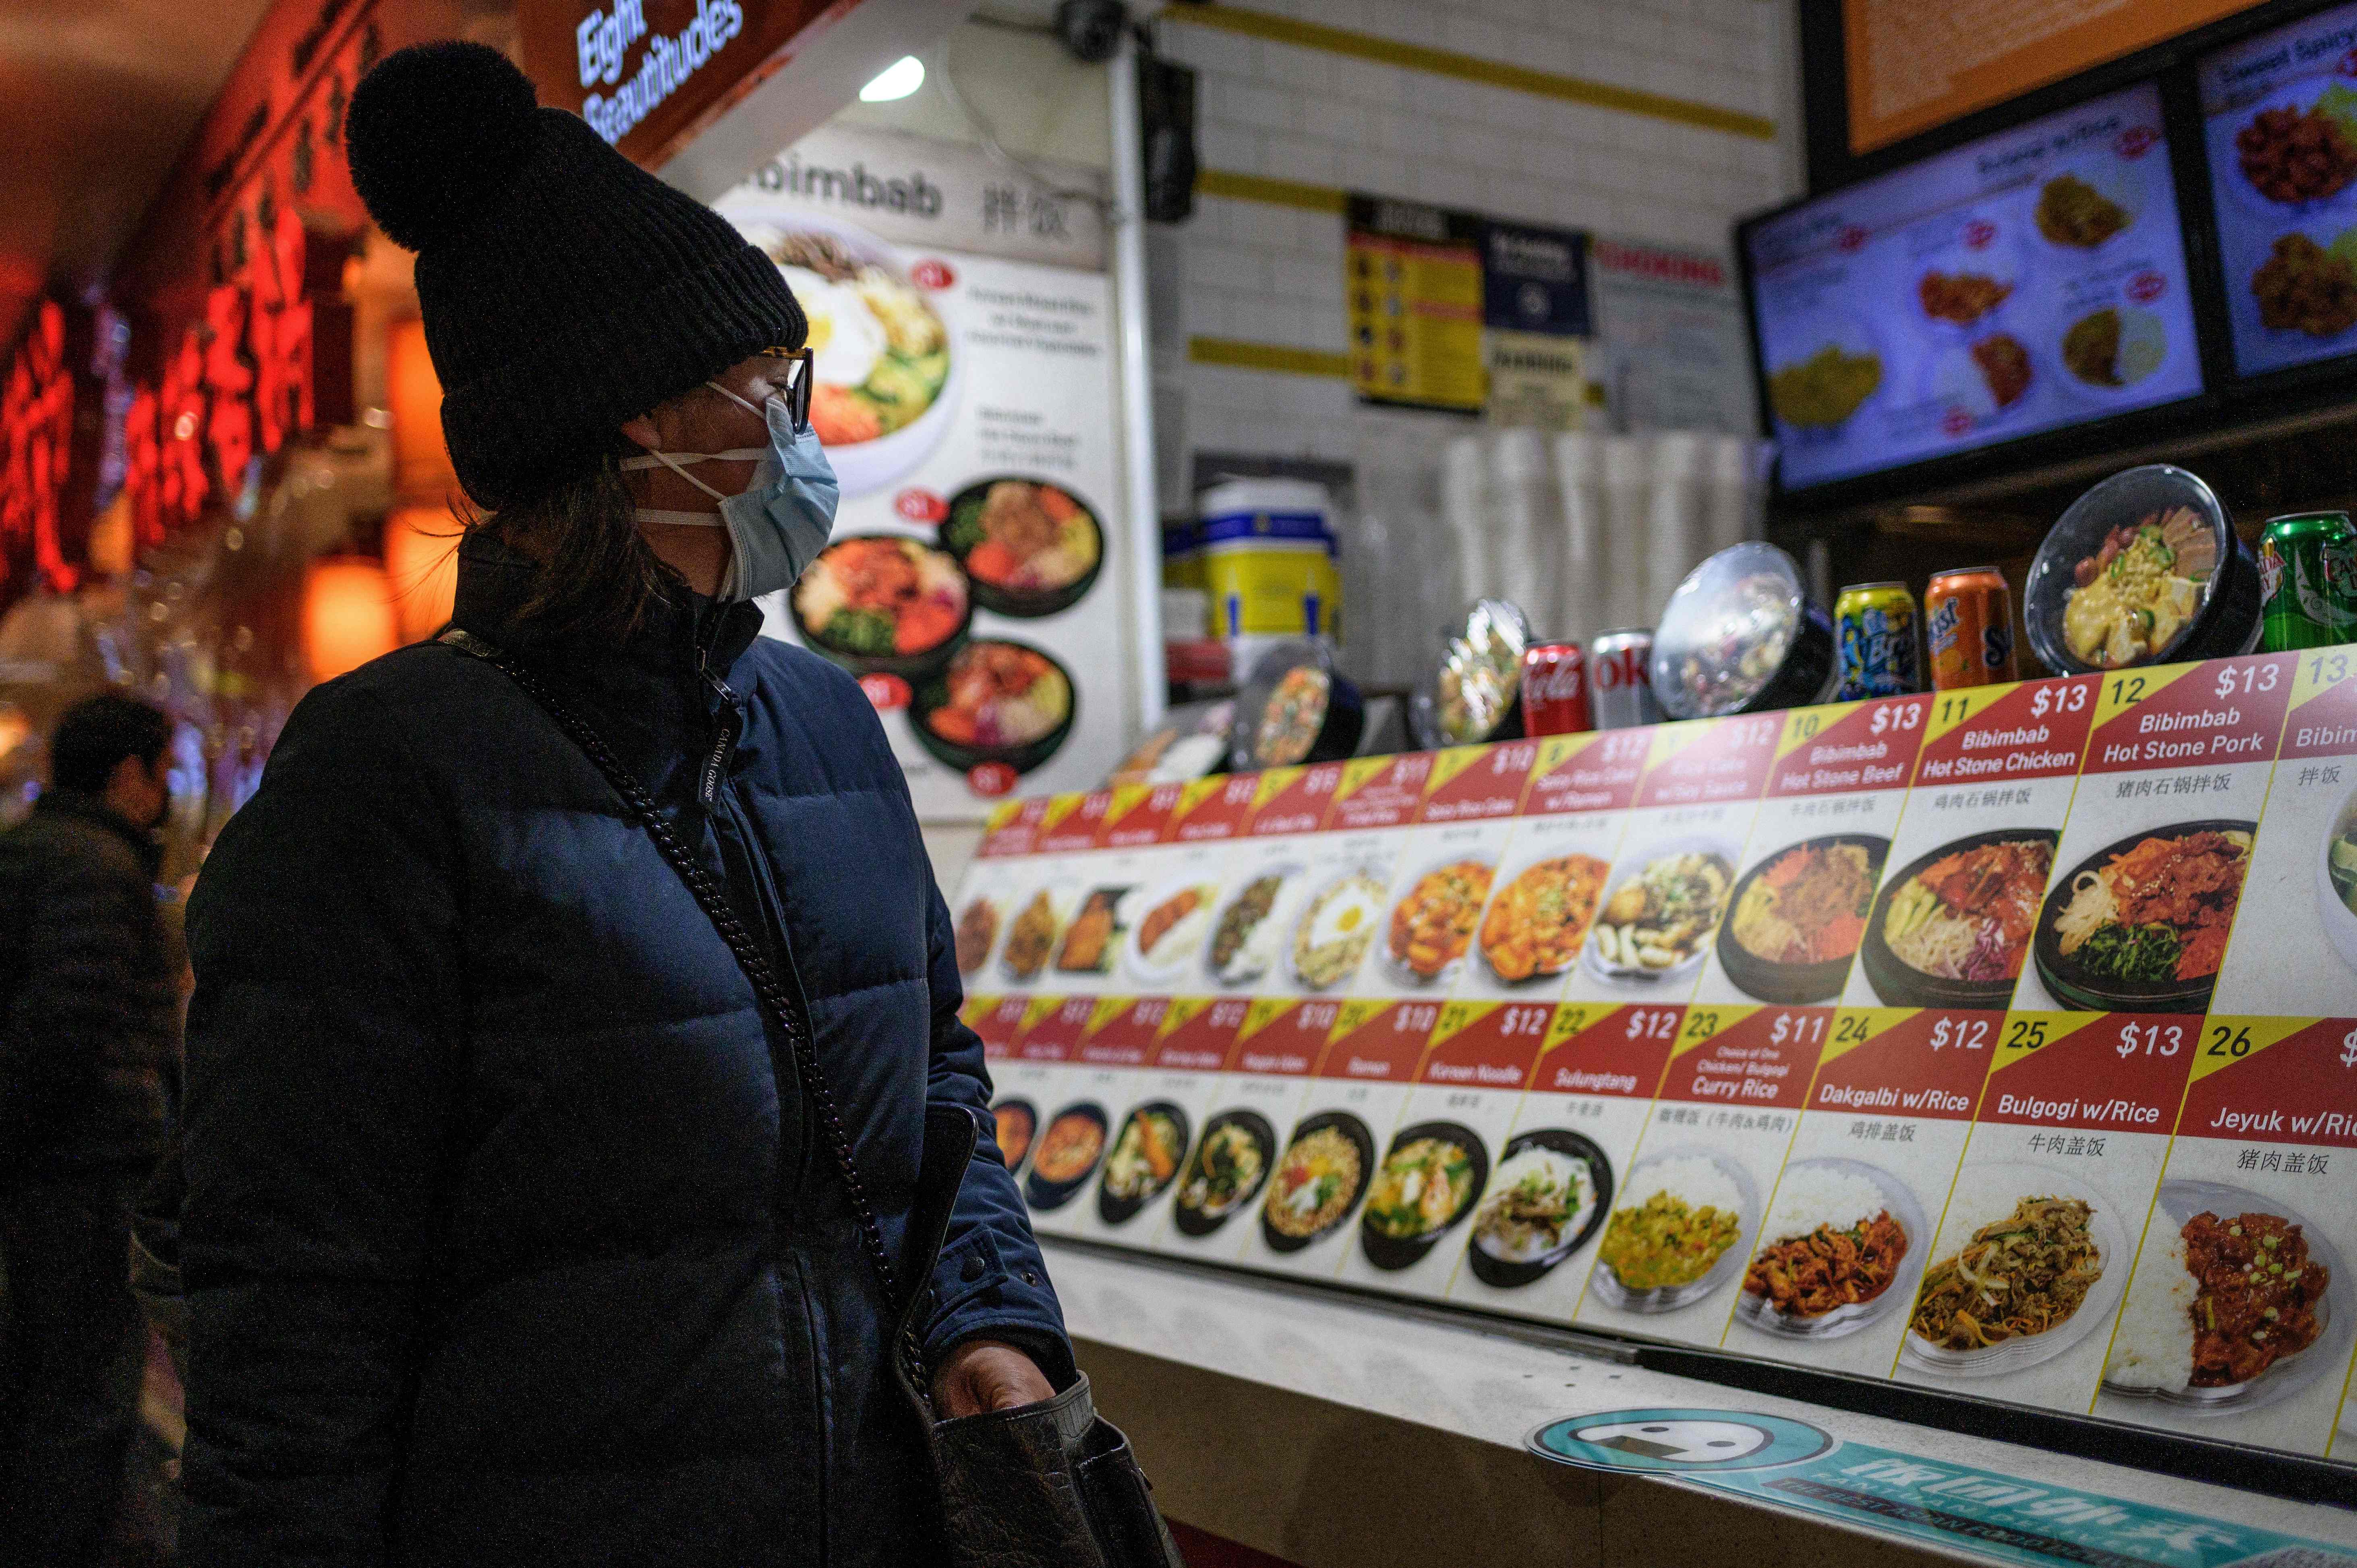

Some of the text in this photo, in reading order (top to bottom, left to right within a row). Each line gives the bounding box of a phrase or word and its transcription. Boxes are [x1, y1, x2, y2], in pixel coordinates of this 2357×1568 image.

[743, 153, 942, 218] bimbab
[2215, 663, 2280, 700] $13
[2310, 654, 2349, 685] 13
[2030, 684, 2088, 719] $13
[2112, 677, 2146, 705] 12
[1870, 702, 1922, 735] $13
[1942, 696, 1970, 723] 11
[2139, 707, 2241, 733] Bibimbab
[1792, 714, 1820, 738] 10
[1961, 725, 2050, 751] Bibimbab
[2296, 725, 2357, 748] Bibim
[1810, 741, 1889, 765] Bibimbab
[2103, 732, 2264, 764] Hot Stone Pork
[705, 728, 730, 802] CANADA GOOSE
[1780, 762, 1904, 791] Hot Stone Beef
[1922, 751, 2076, 779] Hot Stone Chicken
[2299, 765, 2341, 786] 拌饭
[2116, 772, 2232, 798] 猪肉石锅拌饭
[1500, 1006, 1547, 1037] $12
[1556, 1009, 1587, 1034] 22
[1625, 1009, 1678, 1040] $12
[1686, 1011, 1719, 1039] 23
[1769, 1011, 1825, 1045] $11
[1835, 1016, 1870, 1043] 24
[1930, 1016, 1989, 1051] $12
[2007, 1021, 2048, 1049] 25
[2117, 1021, 2183, 1058] $13
[2207, 1026, 2251, 1057] 26
[1554, 1067, 1638, 1094] Sulungtang
[1691, 1075, 1779, 1100] Curry Rice
[1818, 1083, 1970, 1112] Dakgalbi w/Rice
[1998, 1094, 2160, 1123] Bulgogi w/Rice
[2210, 1107, 2357, 1135] Jeyuk w/Ri
[2027, 1133, 2106, 1157] 牛肉盖饭
[2237, 1149, 2330, 1175] 猪肉盖饭
